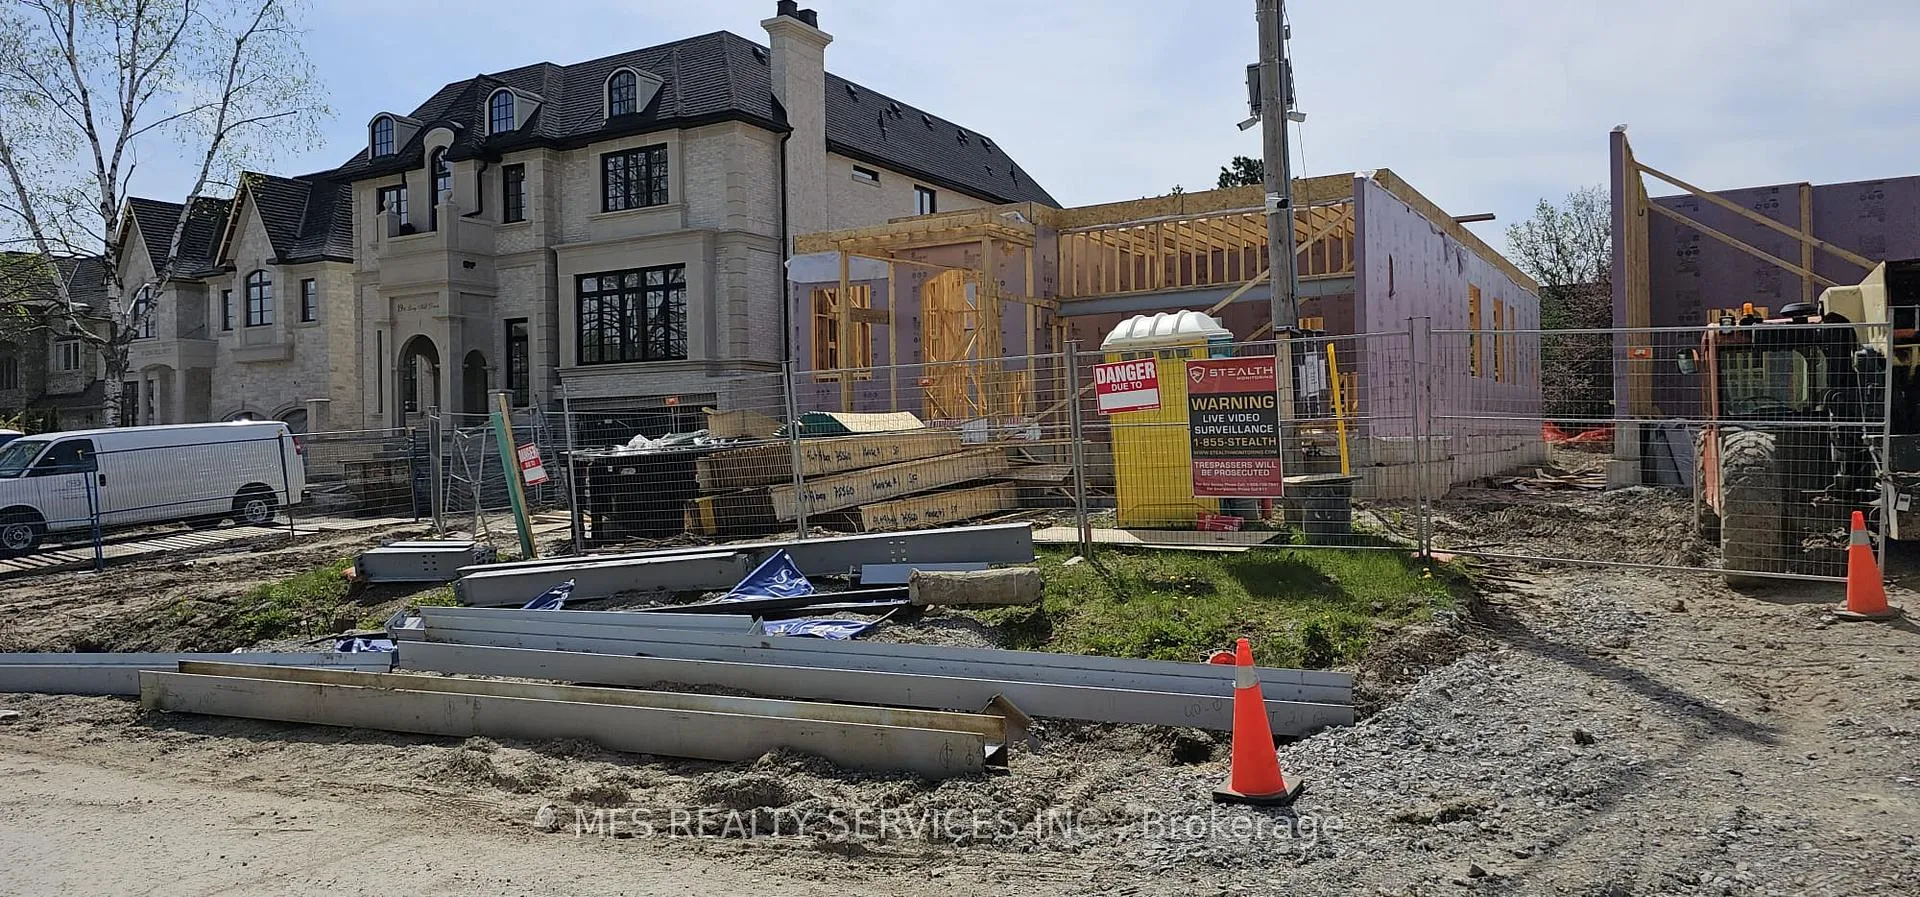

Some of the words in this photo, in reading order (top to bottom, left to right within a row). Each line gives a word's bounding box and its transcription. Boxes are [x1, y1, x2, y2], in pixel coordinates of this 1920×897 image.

[1096, 361, 1156, 385] DANGER
[1209, 366, 1274, 377] STEALTH
[1111, 382, 1129, 392] DUE
[1130, 380, 1143, 390] TO
[1191, 395, 1275, 411] WARNING
[1202, 414, 1225, 423] LIVE
[1227, 413, 1260, 422] VIDEO
[1194, 424, 1275, 434] SURVEILLANCE
[1193, 436, 1277, 447] 1-855-STEALTH
[1194, 461, 1253, 469] TRESPASSERS
[1254, 461, 1278, 469] WILL
